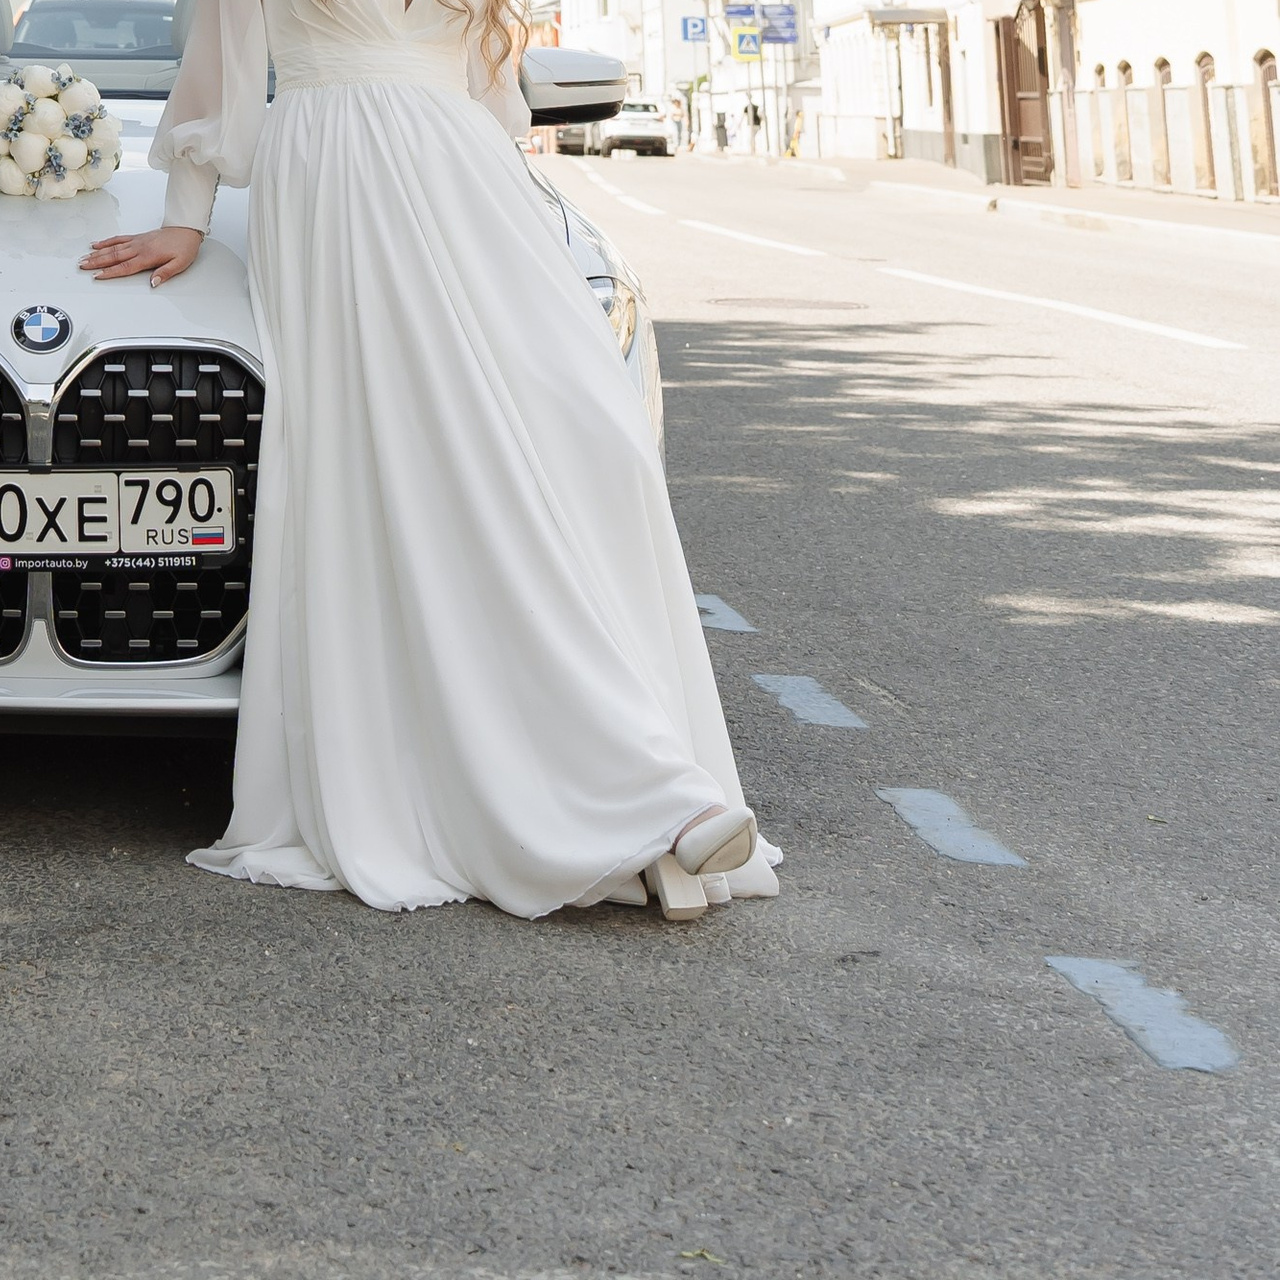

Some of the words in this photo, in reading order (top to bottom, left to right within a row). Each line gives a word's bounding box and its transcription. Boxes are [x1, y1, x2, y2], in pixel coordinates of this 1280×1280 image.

[687, 17, 703, 40] P
[20, 306, 66, 320] BMW
[123, 477, 216, 525] 790
[146, 528, 190, 546] RUS
[14, 558, 89, 570] importauto.by
[104, 557, 156, 569] +375(44)
[157, 555, 197, 567] 5119151
